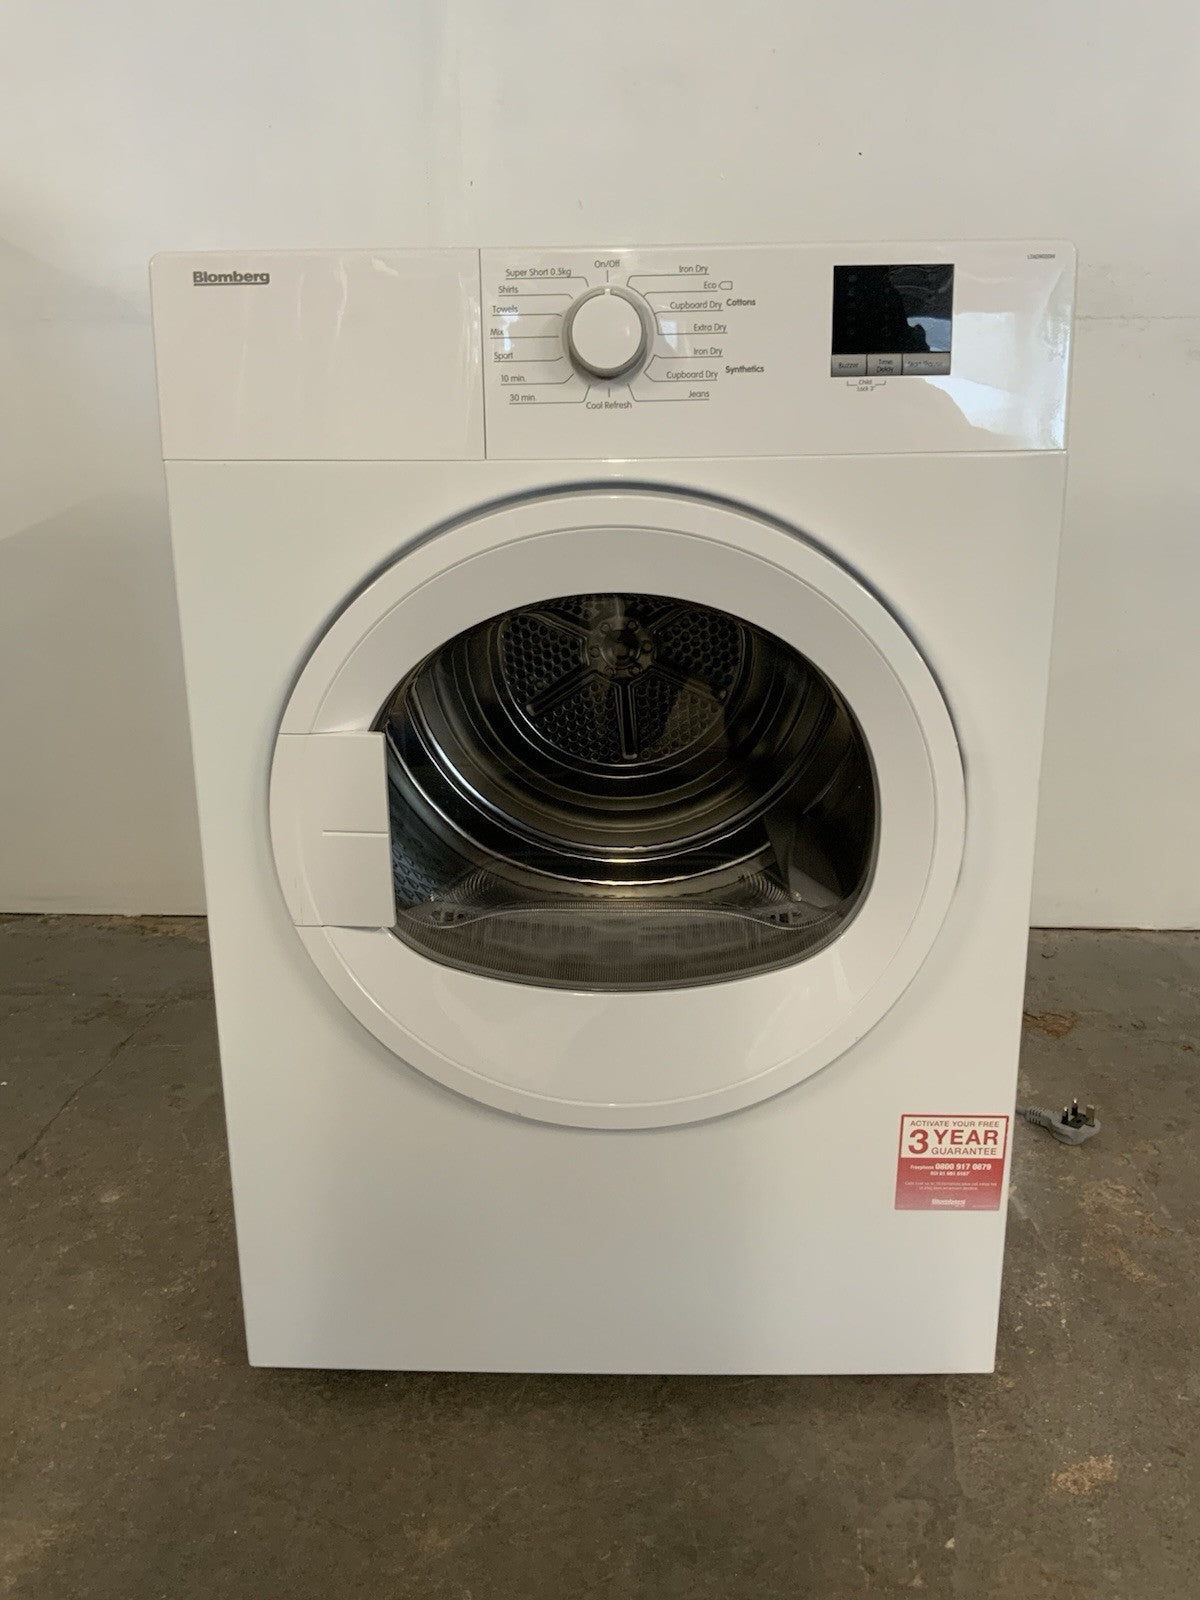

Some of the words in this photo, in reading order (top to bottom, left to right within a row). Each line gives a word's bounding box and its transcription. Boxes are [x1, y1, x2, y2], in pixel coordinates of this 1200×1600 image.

[594, 260, 620, 268] On/Off
[505, 268, 528, 278] Super
[529, 268, 549, 276] Short
[550, 268, 572, 278] 0.5kg
[679, 265, 694, 273] Iron
[695, 264, 709, 274] Dry
[193, 271, 270, 286] Blomberg
[498, 285, 519, 294] Shirts
[703, 281, 717, 289] Eco
[492, 305, 519, 313] Towels
[669, 301, 708, 310] Cupboard
[709, 301, 723, 310] Dry
[490, 328, 504, 336] Mix
[693, 323, 712, 331] Extra
[714, 323, 727, 333] Dry
[494, 352, 513, 361] Sport
[693, 347, 708, 355] Iron
[710, 347, 723, 357] Dry
[725, 365, 765, 375] Synthetics
[666, 371, 704, 380] Cupboard
[705, 370, 719, 379] Dry
[688, 390, 710, 398] Jeans
[586, 401, 603, 410] Cool
[604, 401, 633, 410] Refresh
[908, 1129, 929, 1154] 3
[933, 1129, 999, 1145] YEAR
[931, 1147, 997, 1155] GUARANTEE
